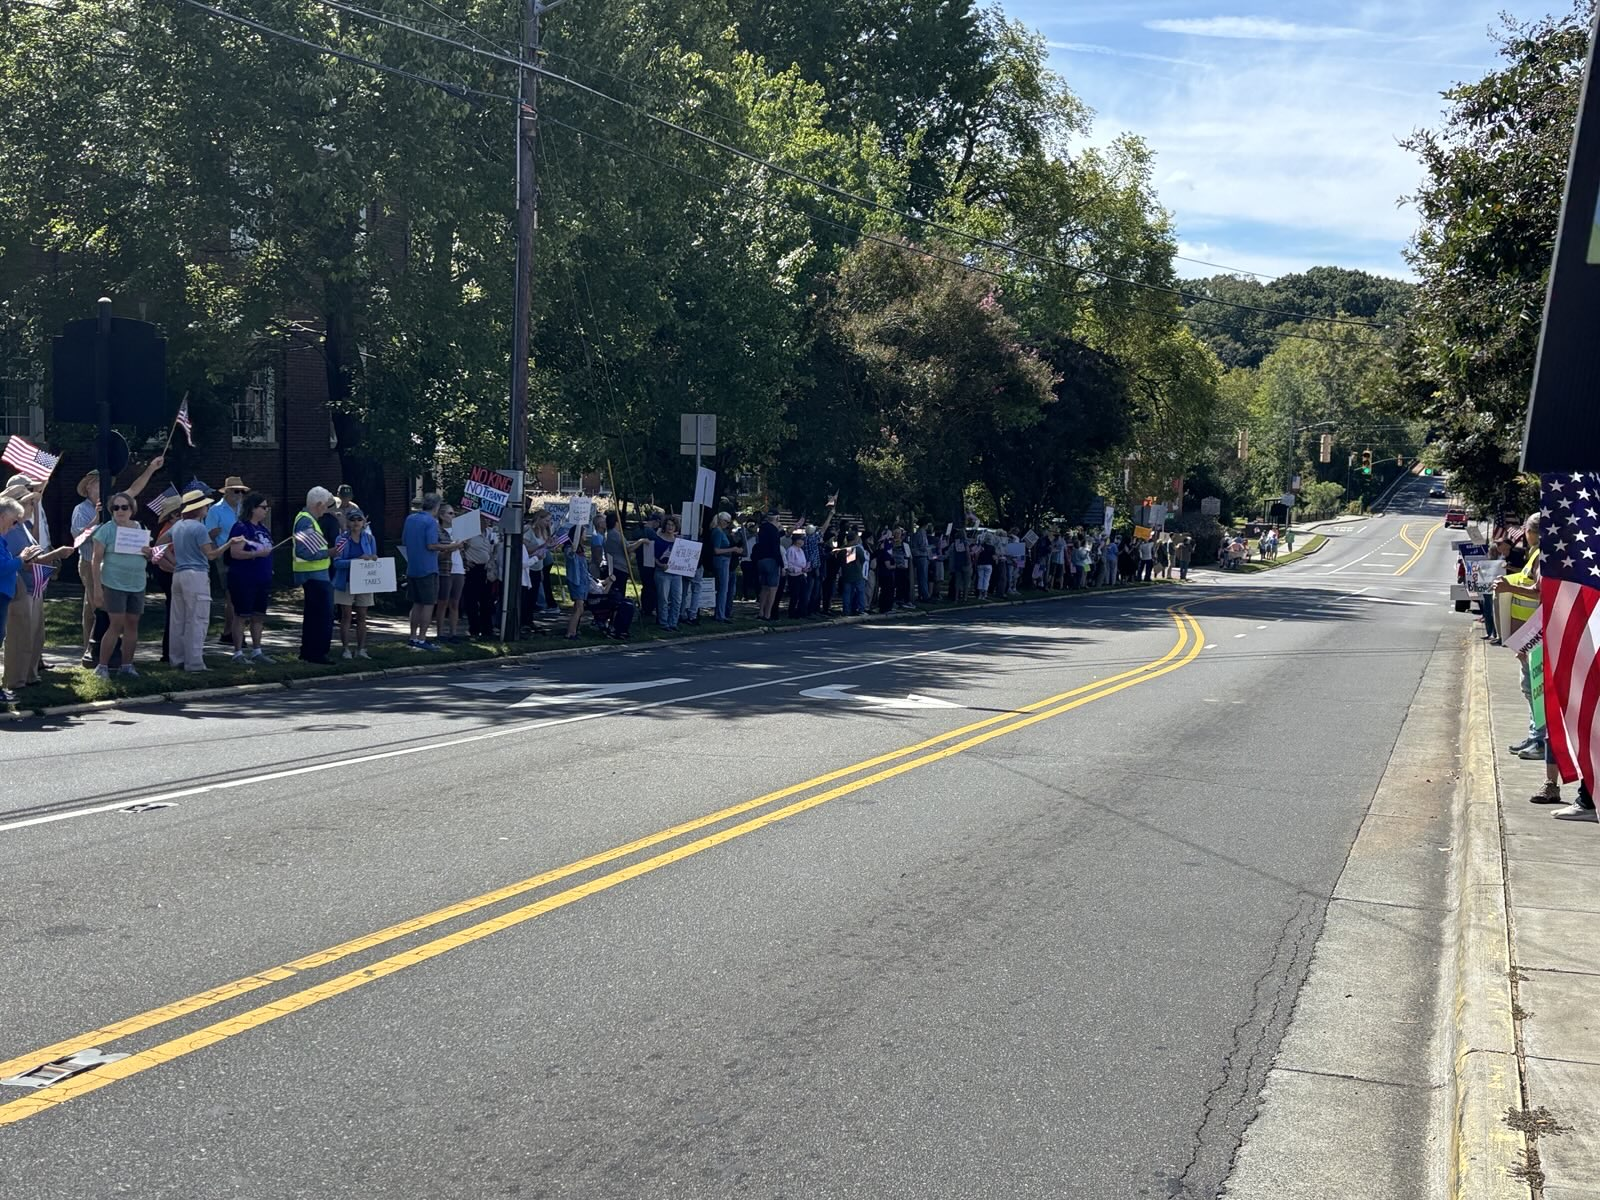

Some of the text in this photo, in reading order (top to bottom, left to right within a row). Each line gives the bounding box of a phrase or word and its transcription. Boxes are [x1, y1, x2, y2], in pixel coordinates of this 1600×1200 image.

[470, 465, 488, 484] NO
[467, 480, 483, 496] NO
[480, 498, 504, 517] SILENT
[1519, 628, 1543, 655] WORKE
